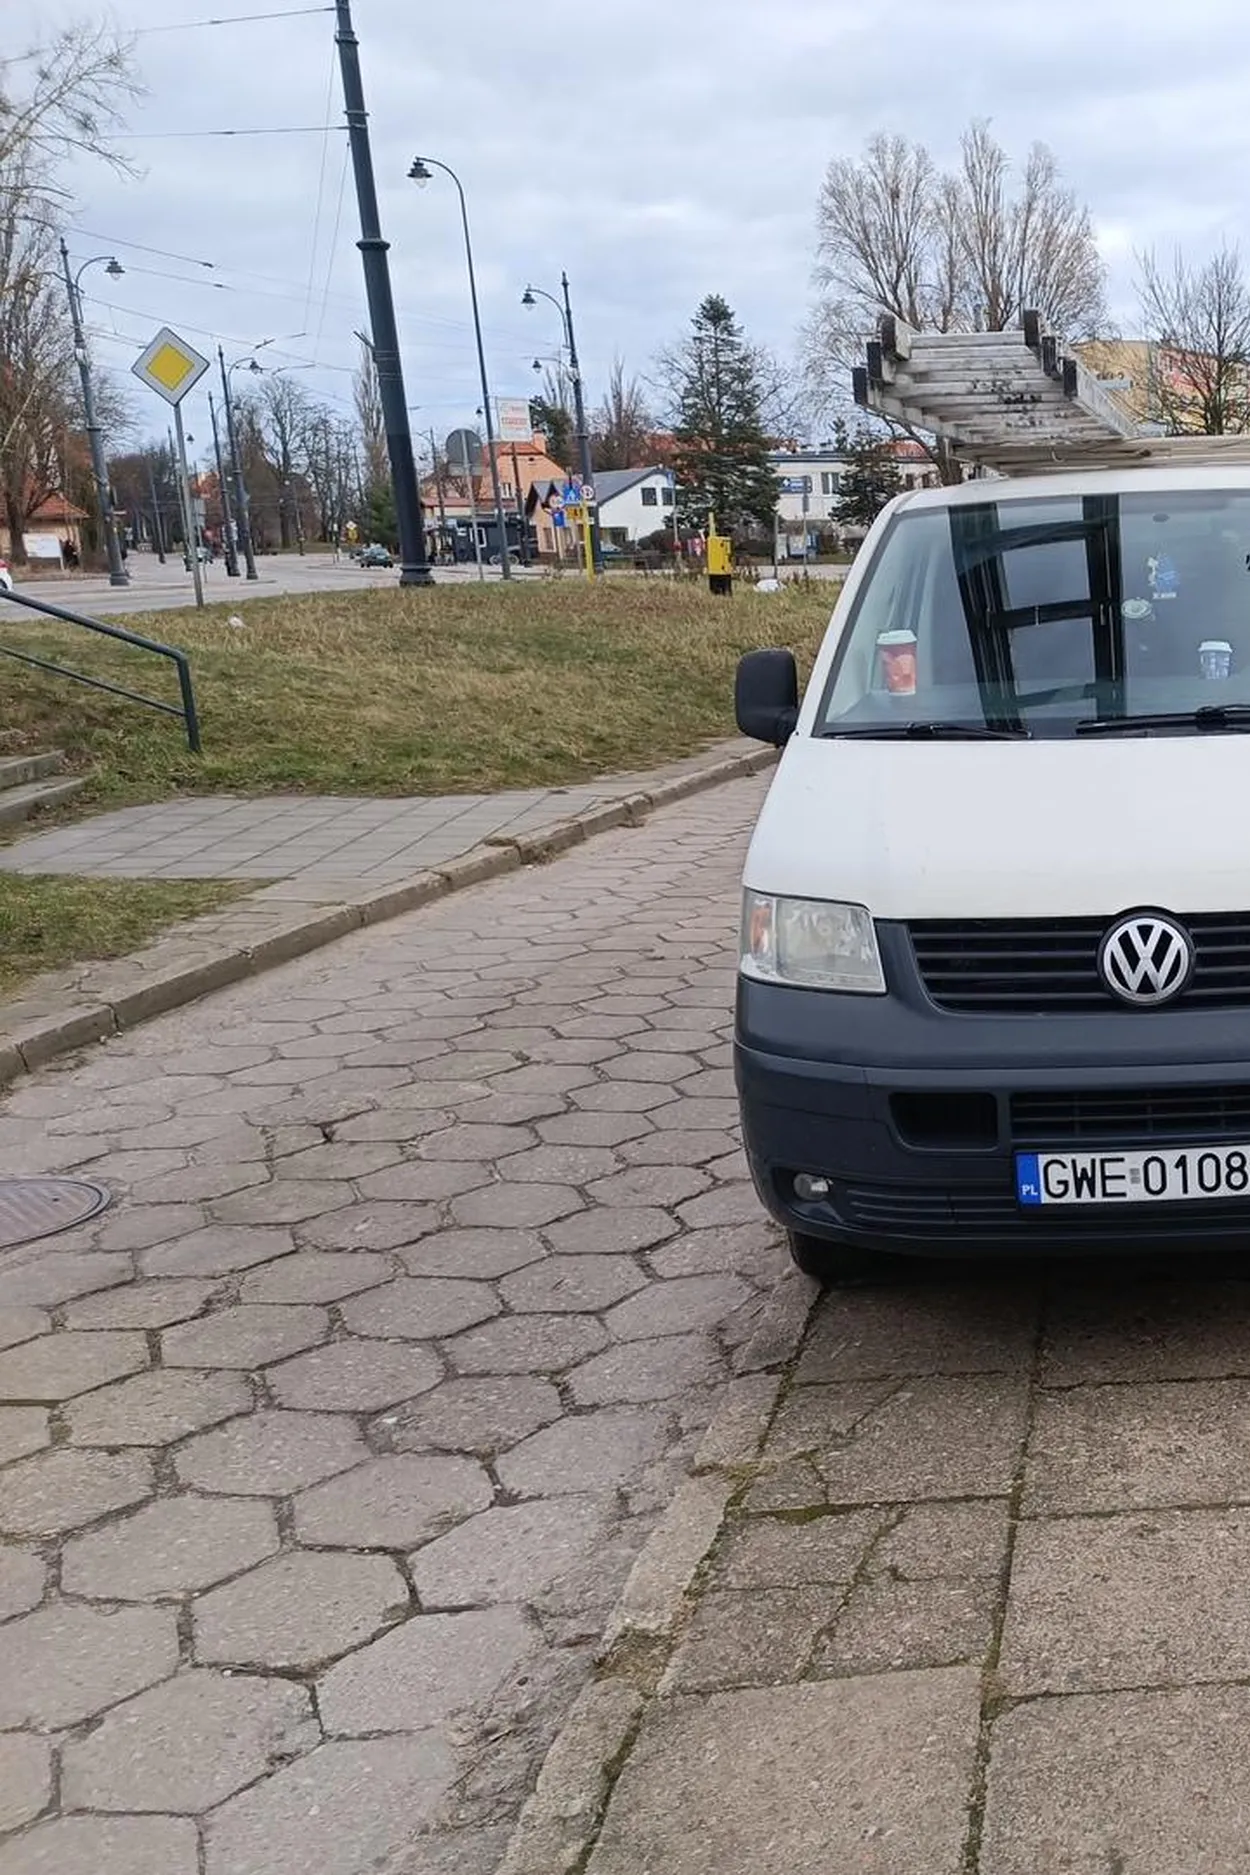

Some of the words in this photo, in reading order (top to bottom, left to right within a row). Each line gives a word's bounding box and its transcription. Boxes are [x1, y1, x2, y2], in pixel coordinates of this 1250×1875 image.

[1104, 918, 1189, 1002] VW
[1021, 1184, 1039, 1196] PL
[1042, 1157, 1127, 1199] GWE
